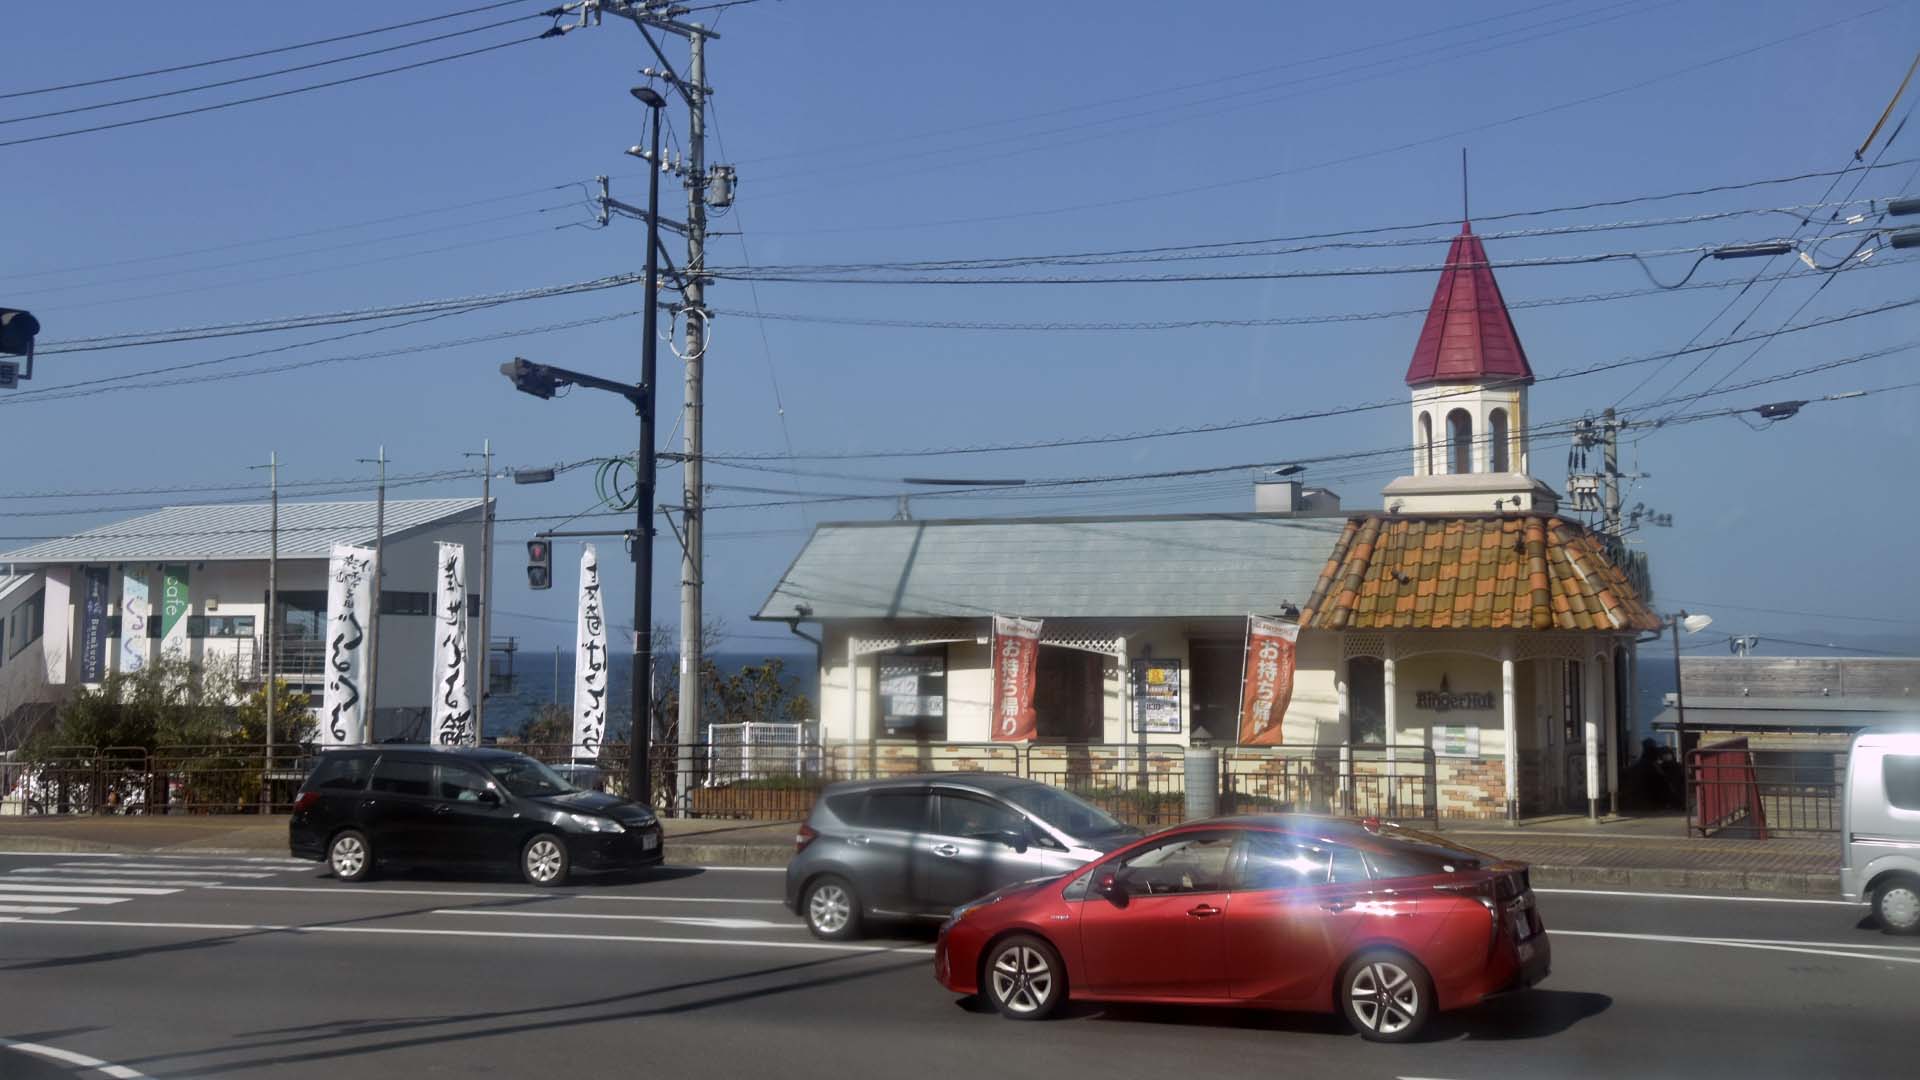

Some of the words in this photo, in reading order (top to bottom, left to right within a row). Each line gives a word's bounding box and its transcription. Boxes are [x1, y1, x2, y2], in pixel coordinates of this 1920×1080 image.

[166, 577, 184, 616] cafe
[89, 618, 100, 679] Baumkuchen
[124, 595, 144, 670] ぐるぐる
[1002, 639, 1021, 736] お持ち帰り
